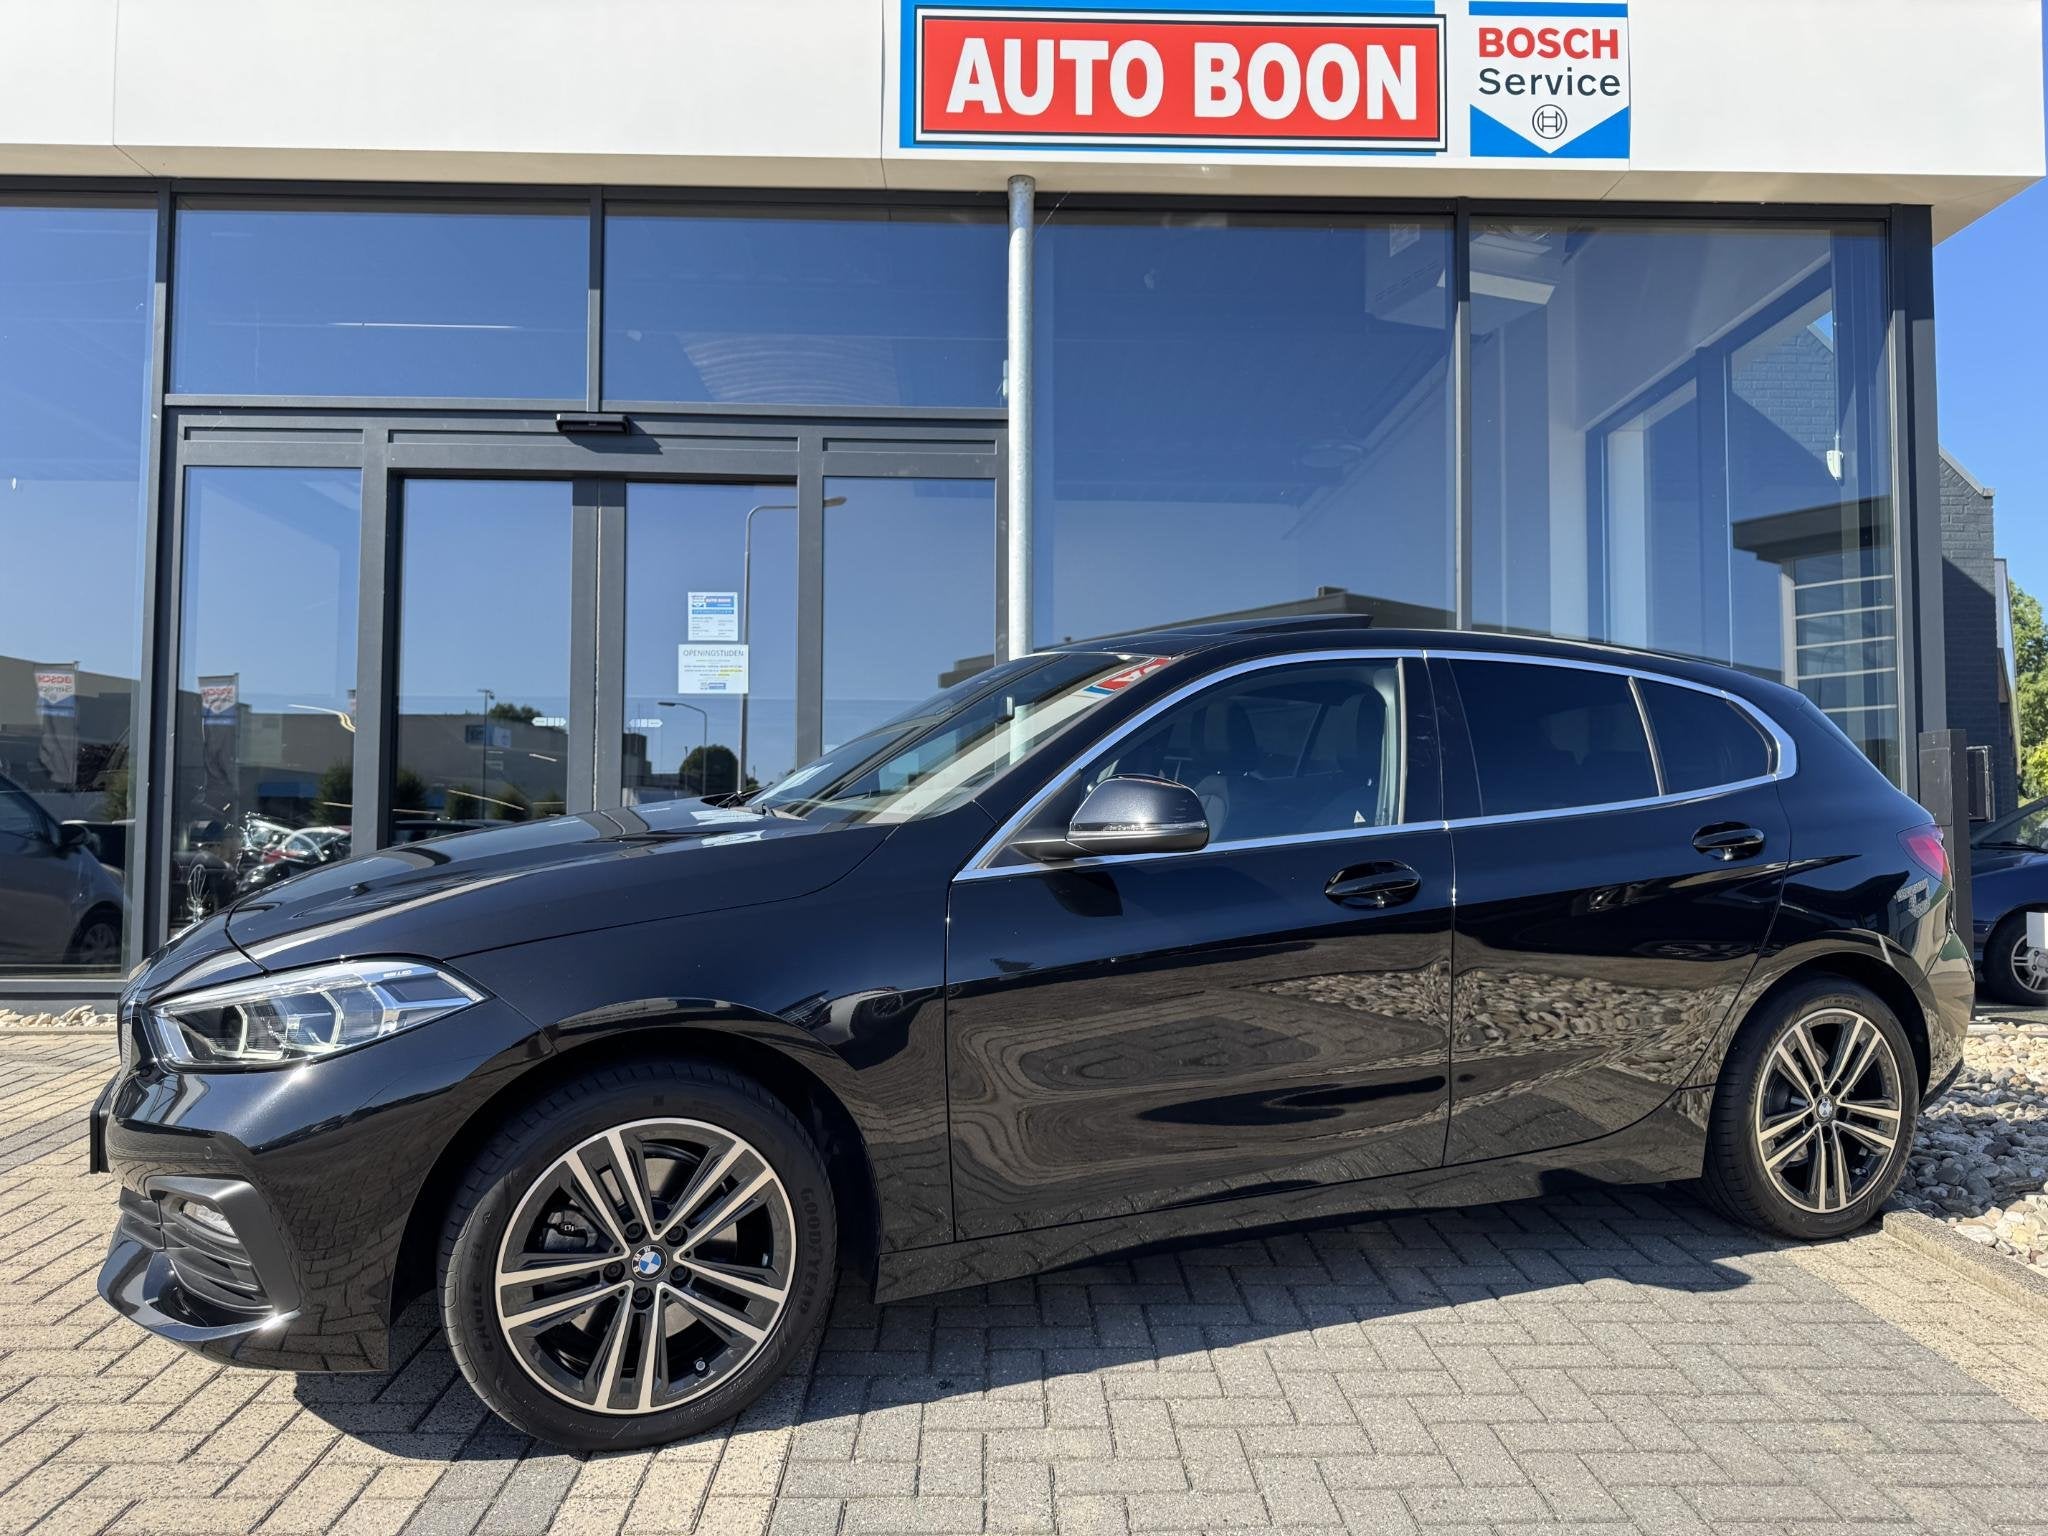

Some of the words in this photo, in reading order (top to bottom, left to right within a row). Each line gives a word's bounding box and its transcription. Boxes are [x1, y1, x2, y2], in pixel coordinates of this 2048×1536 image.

[1478, 27, 1619, 59] BOSCH
[946, 37, 1164, 118] AUTO
[1194, 42, 1417, 120] BOON
[1478, 67, 1621, 96] Service
[683, 649, 744, 657] OPENINGSTIJDEN
[799, 1187, 822, 1315] GOODYEAR
